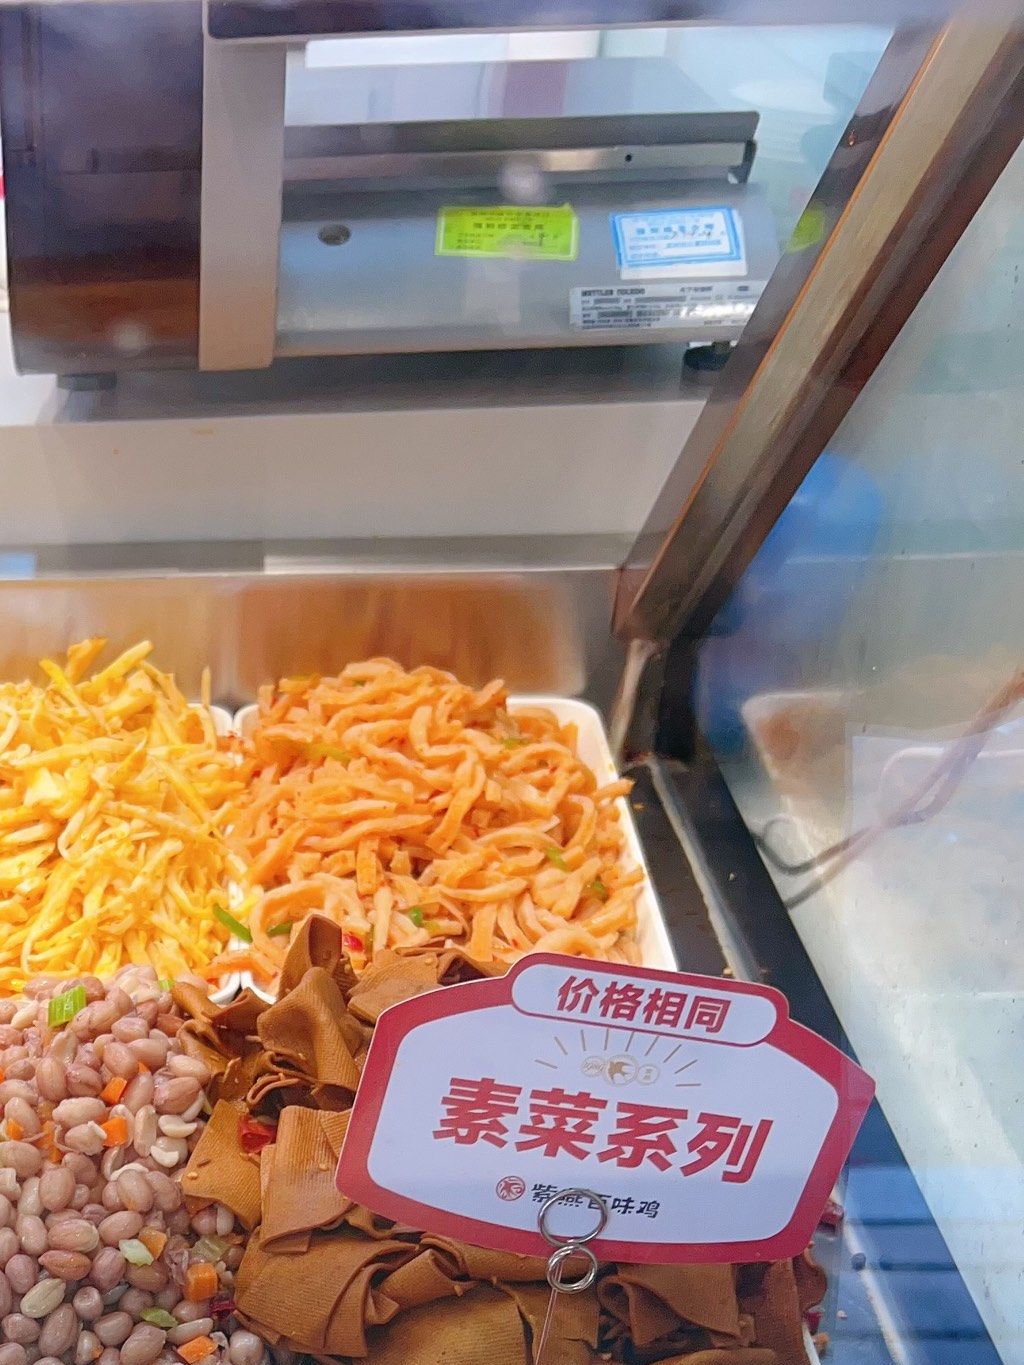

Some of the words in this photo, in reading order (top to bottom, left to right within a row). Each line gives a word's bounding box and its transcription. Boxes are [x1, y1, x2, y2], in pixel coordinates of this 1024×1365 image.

[556, 974, 732, 1035] 价格相同
[432, 1076, 774, 1185] 素菜系列
